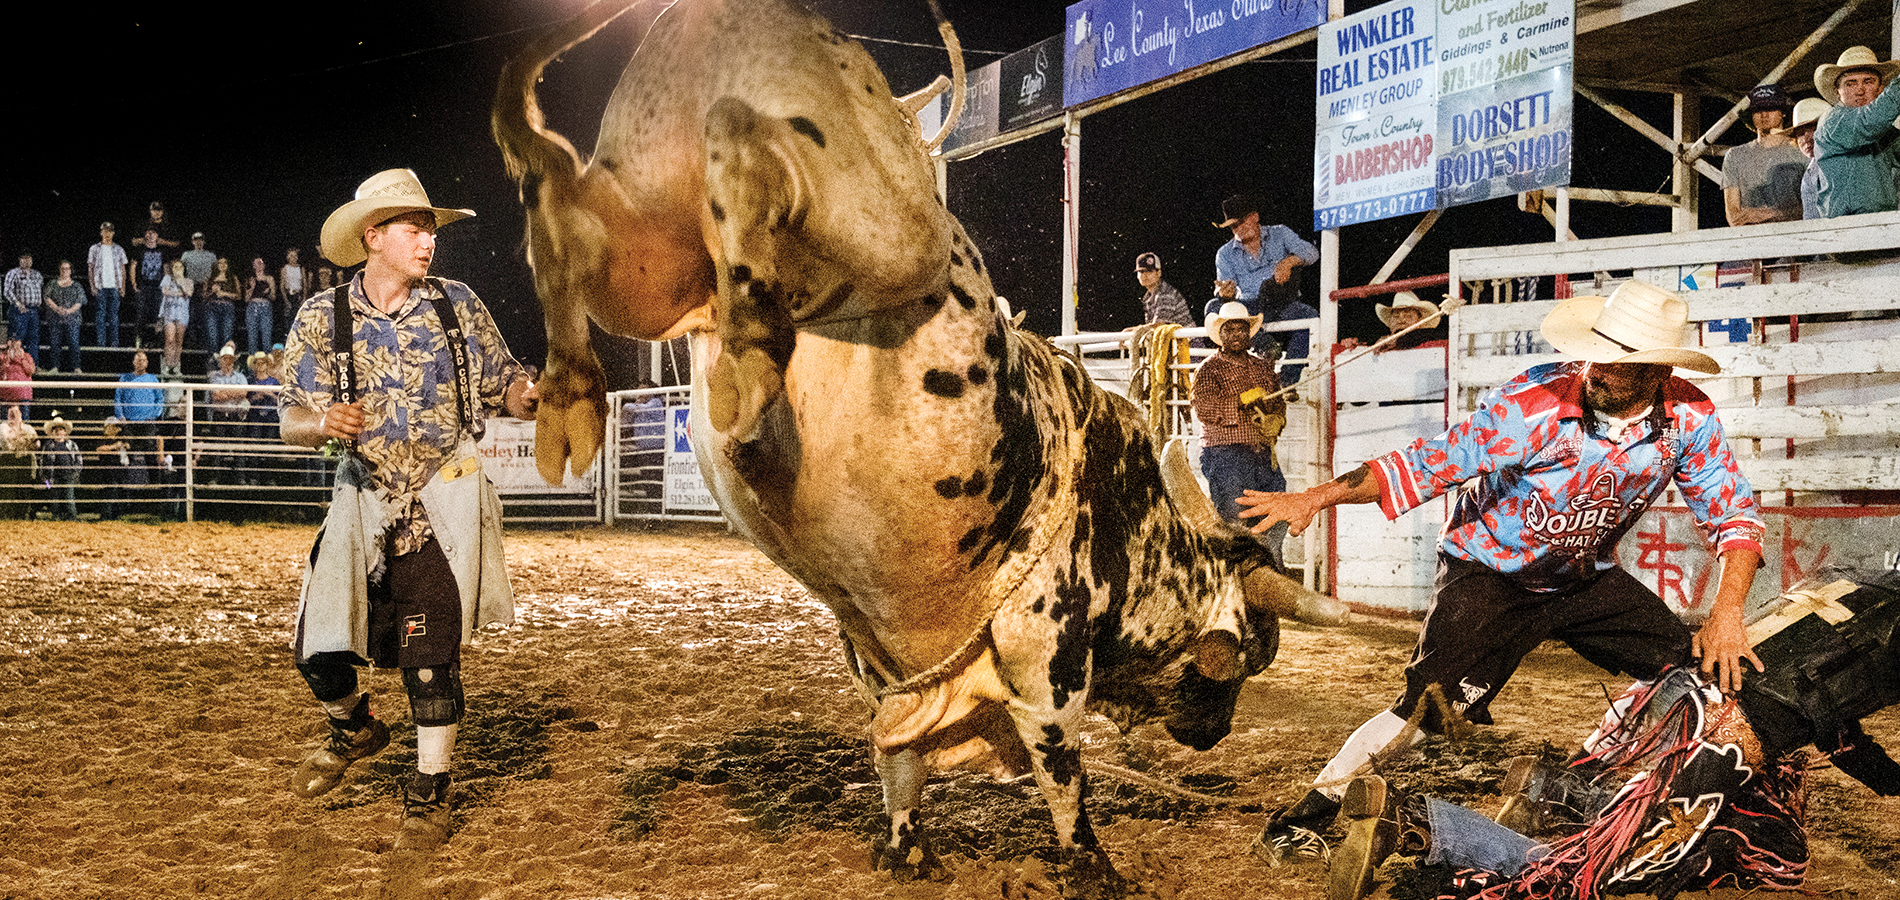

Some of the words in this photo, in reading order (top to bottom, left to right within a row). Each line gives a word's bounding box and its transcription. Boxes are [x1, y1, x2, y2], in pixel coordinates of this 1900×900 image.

[1102, 21, 1127, 68] Lee
[1132, 0, 1176, 66] County
[1337, 6, 1415, 57] WINKLER
[1441, 39, 1491, 62] Giddings
[1500, 32, 1509, 45] &
[1517, 16, 1569, 40] Carmine
[1458, 14, 1484, 39] and
[1487, 2, 1548, 31] Fertilizer
[1320, 58, 1363, 97] REAL
[1368, 35, 1435, 83] ESTATE
[1539, 41, 1569, 56] Nutrena
[1328, 91, 1377, 119] MENLEY
[1379, 78, 1423, 105] GROUP
[1452, 90, 1554, 147] DORSETT
[1342, 125, 1371, 147] Town
[1381, 115, 1424, 134] Country
[1504, 130, 1568, 176] SHOP
[1335, 134, 1434, 186] BARBERSHOP
[1321, 191, 1427, 229] 979-773-0777
